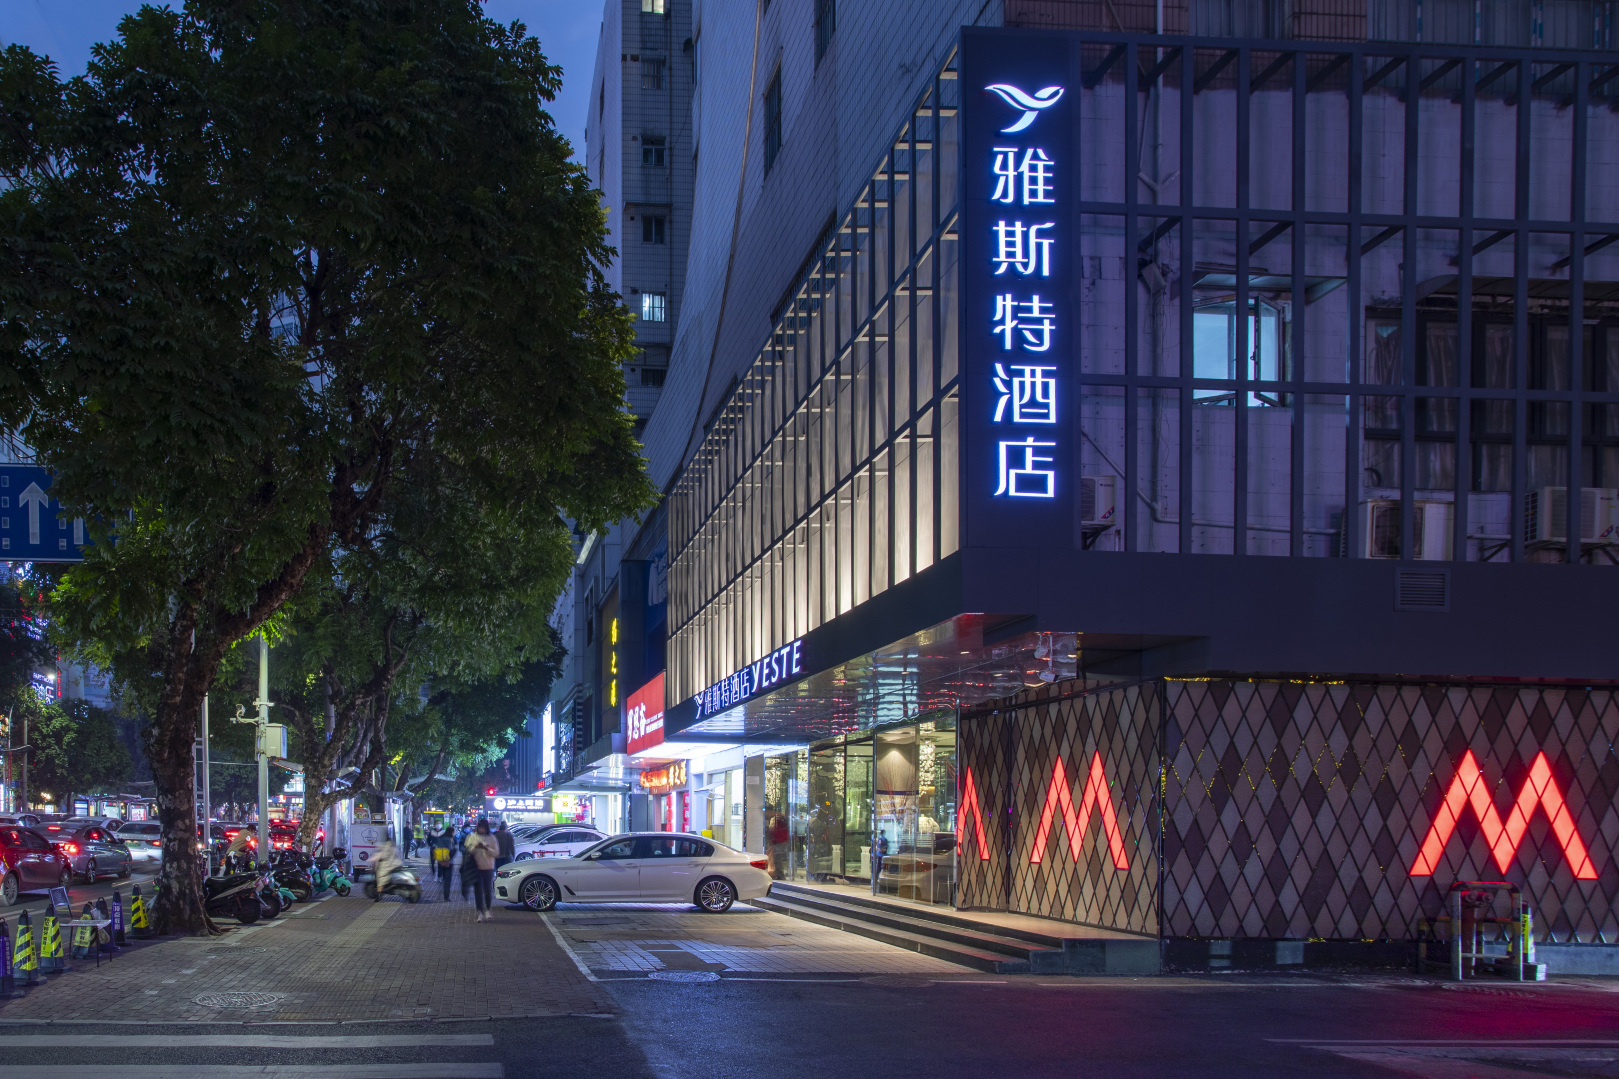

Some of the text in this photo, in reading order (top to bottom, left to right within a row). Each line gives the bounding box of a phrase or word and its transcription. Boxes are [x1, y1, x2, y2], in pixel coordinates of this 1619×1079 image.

[991, 146, 1057, 498] 雅斯特酒店
[704, 667, 750, 715] 雅斯特酒店
[751, 639, 802, 693] YESTE
